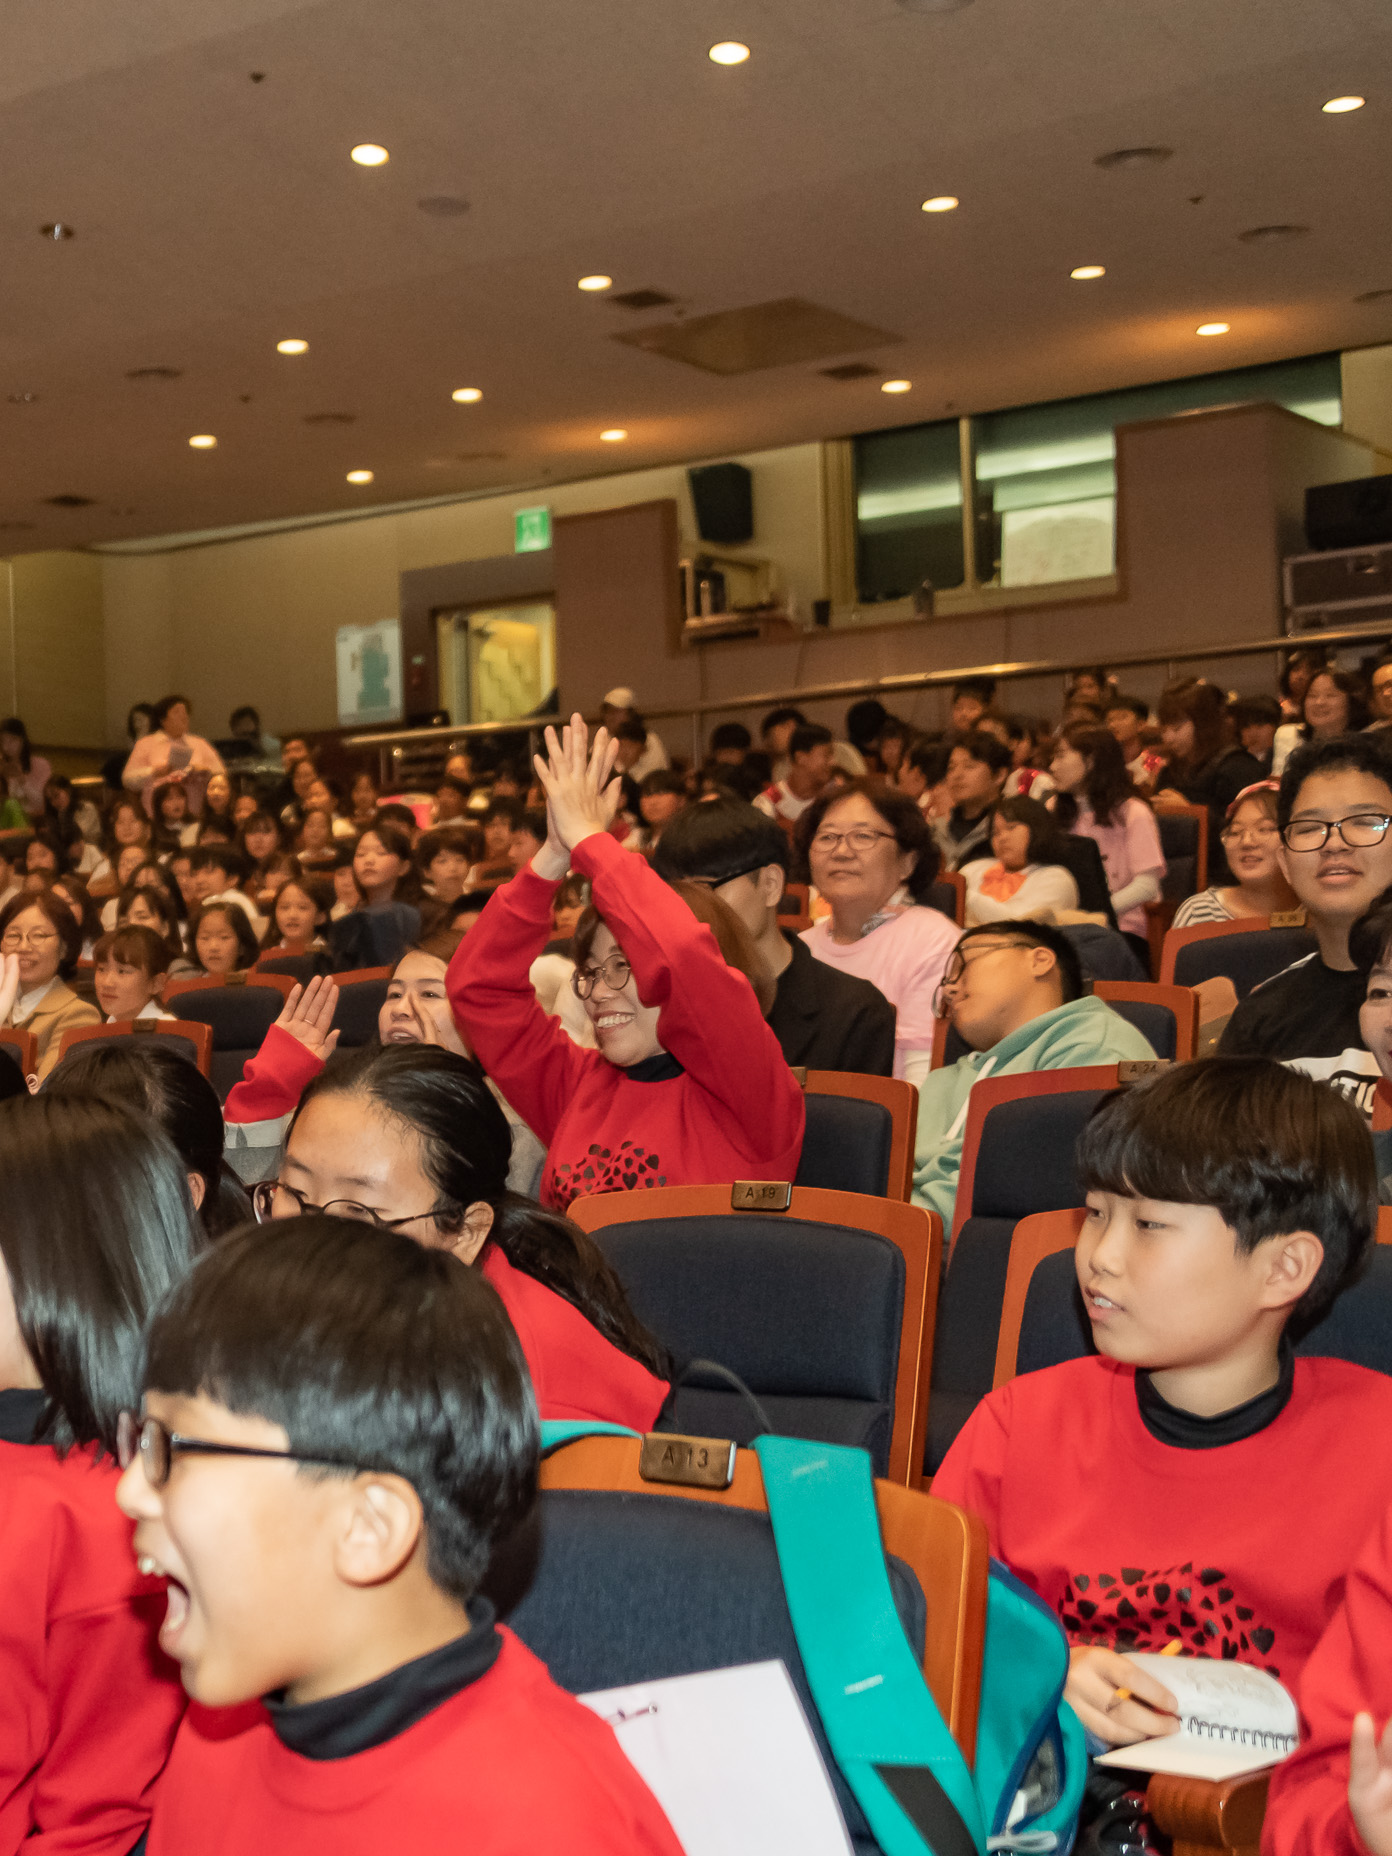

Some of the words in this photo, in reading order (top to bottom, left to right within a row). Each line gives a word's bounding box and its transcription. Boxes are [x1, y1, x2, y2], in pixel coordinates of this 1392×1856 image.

[1130, 1064, 1138, 1073] A
[745, 1186, 754, 1199] A
[762, 1186, 776, 1199] 19
[661, 1444, 674, 1466] A
[688, 1447, 708, 1469] 13
